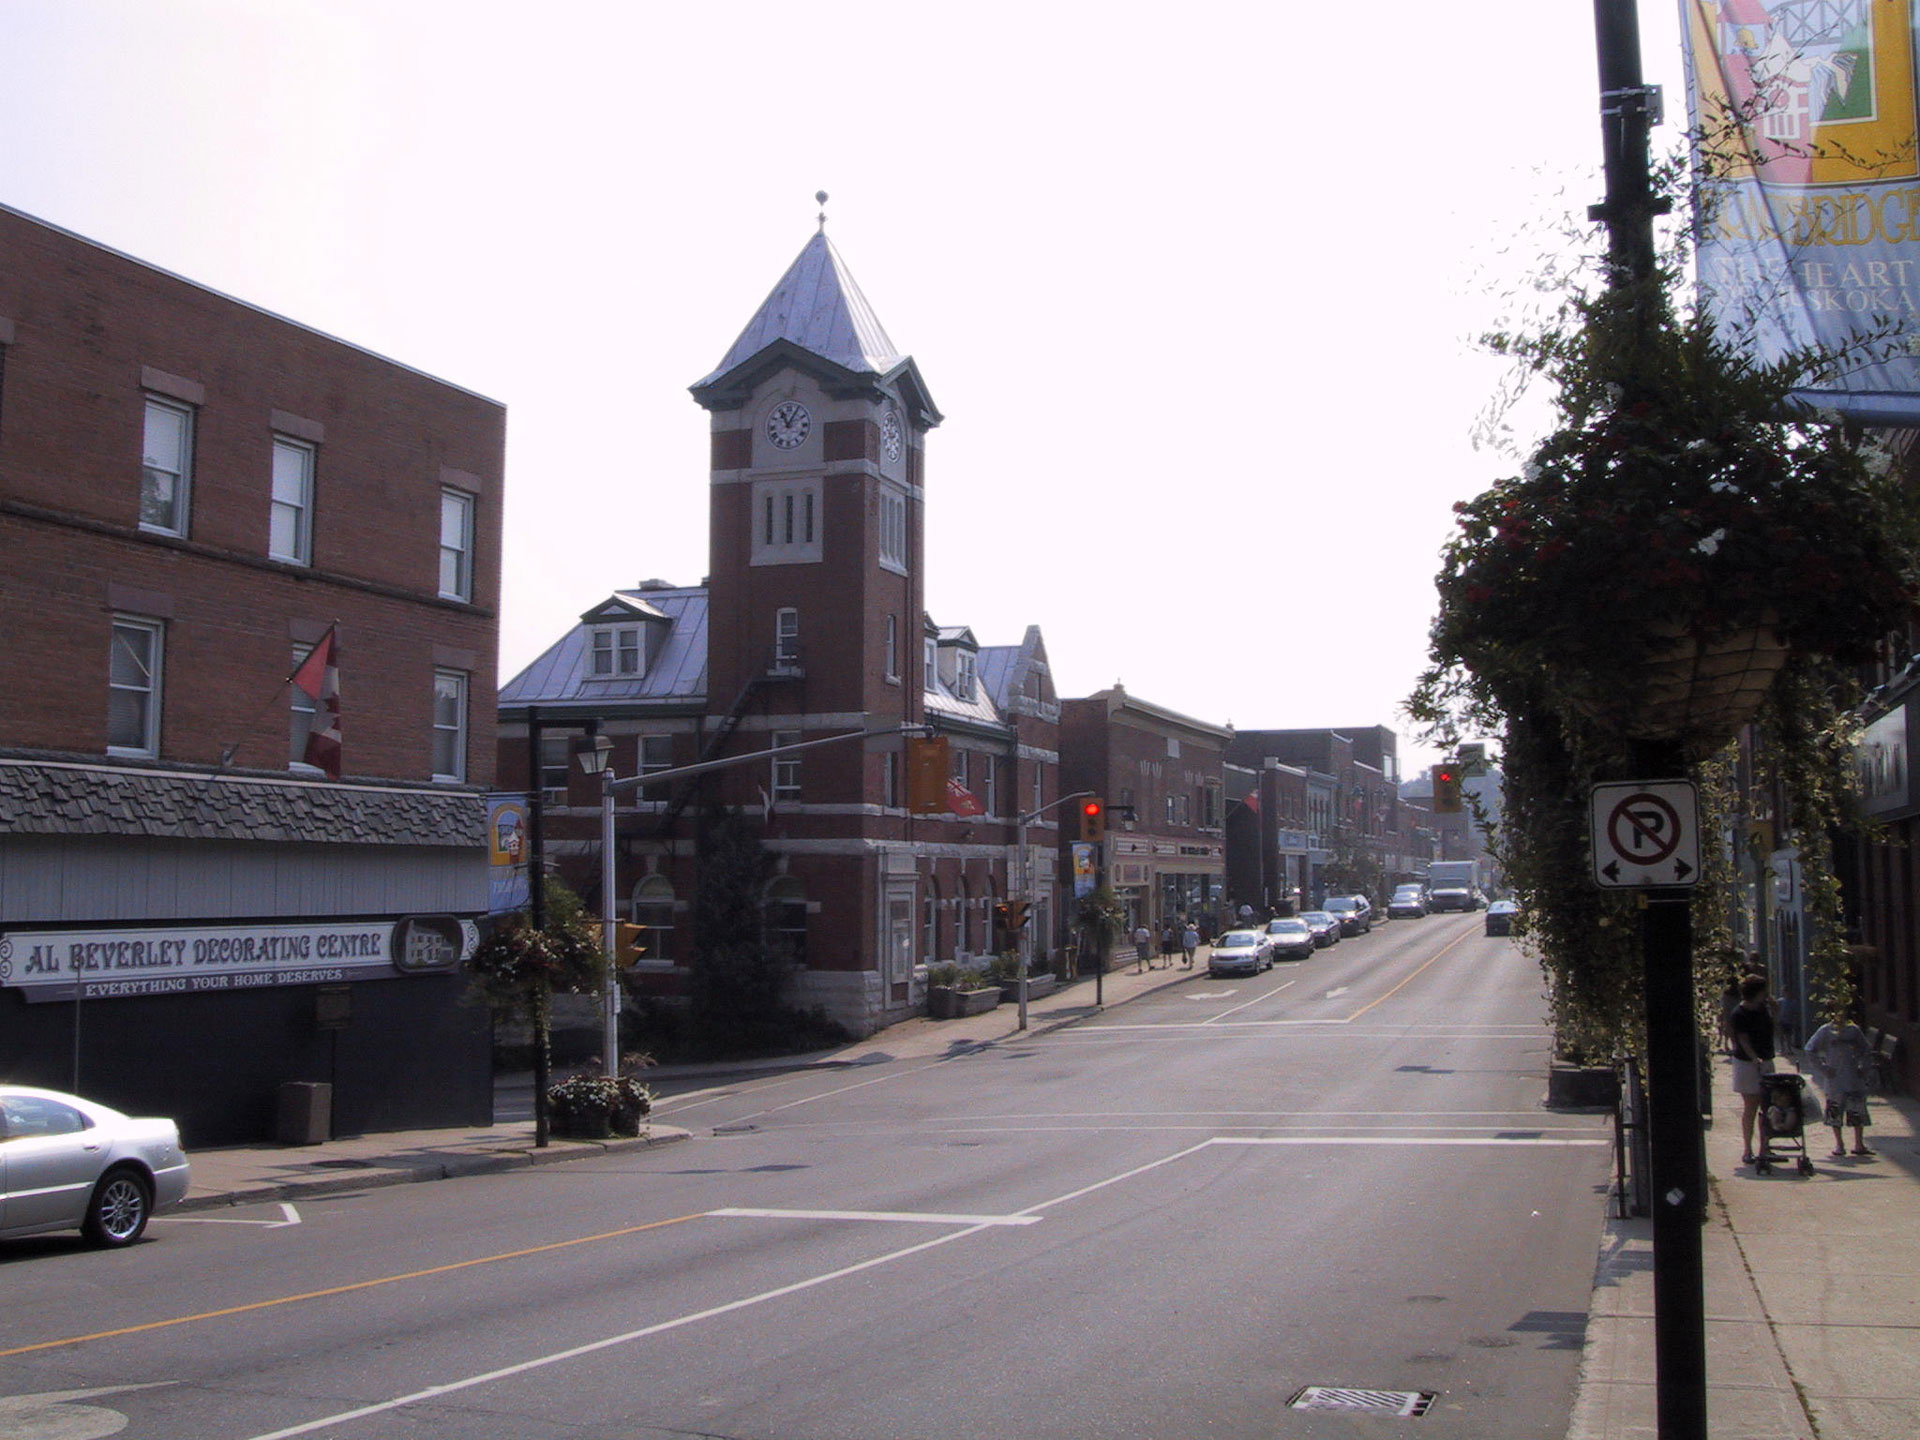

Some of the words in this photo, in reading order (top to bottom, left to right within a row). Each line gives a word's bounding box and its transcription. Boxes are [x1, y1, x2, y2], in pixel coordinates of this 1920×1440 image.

[1797, 260, 1914, 288] HEART
[25, 945, 60, 974] AL
[68, 939, 186, 970] BEVERLEY
[193, 935, 310, 965] DECORATING
[316, 933, 382, 959] CENTRE
[86, 978, 187, 996] EVERYTHING
[192, 974, 229, 989] YOUR
[234, 973, 274, 987] HOME
[277, 969, 343, 983] DESERVES
